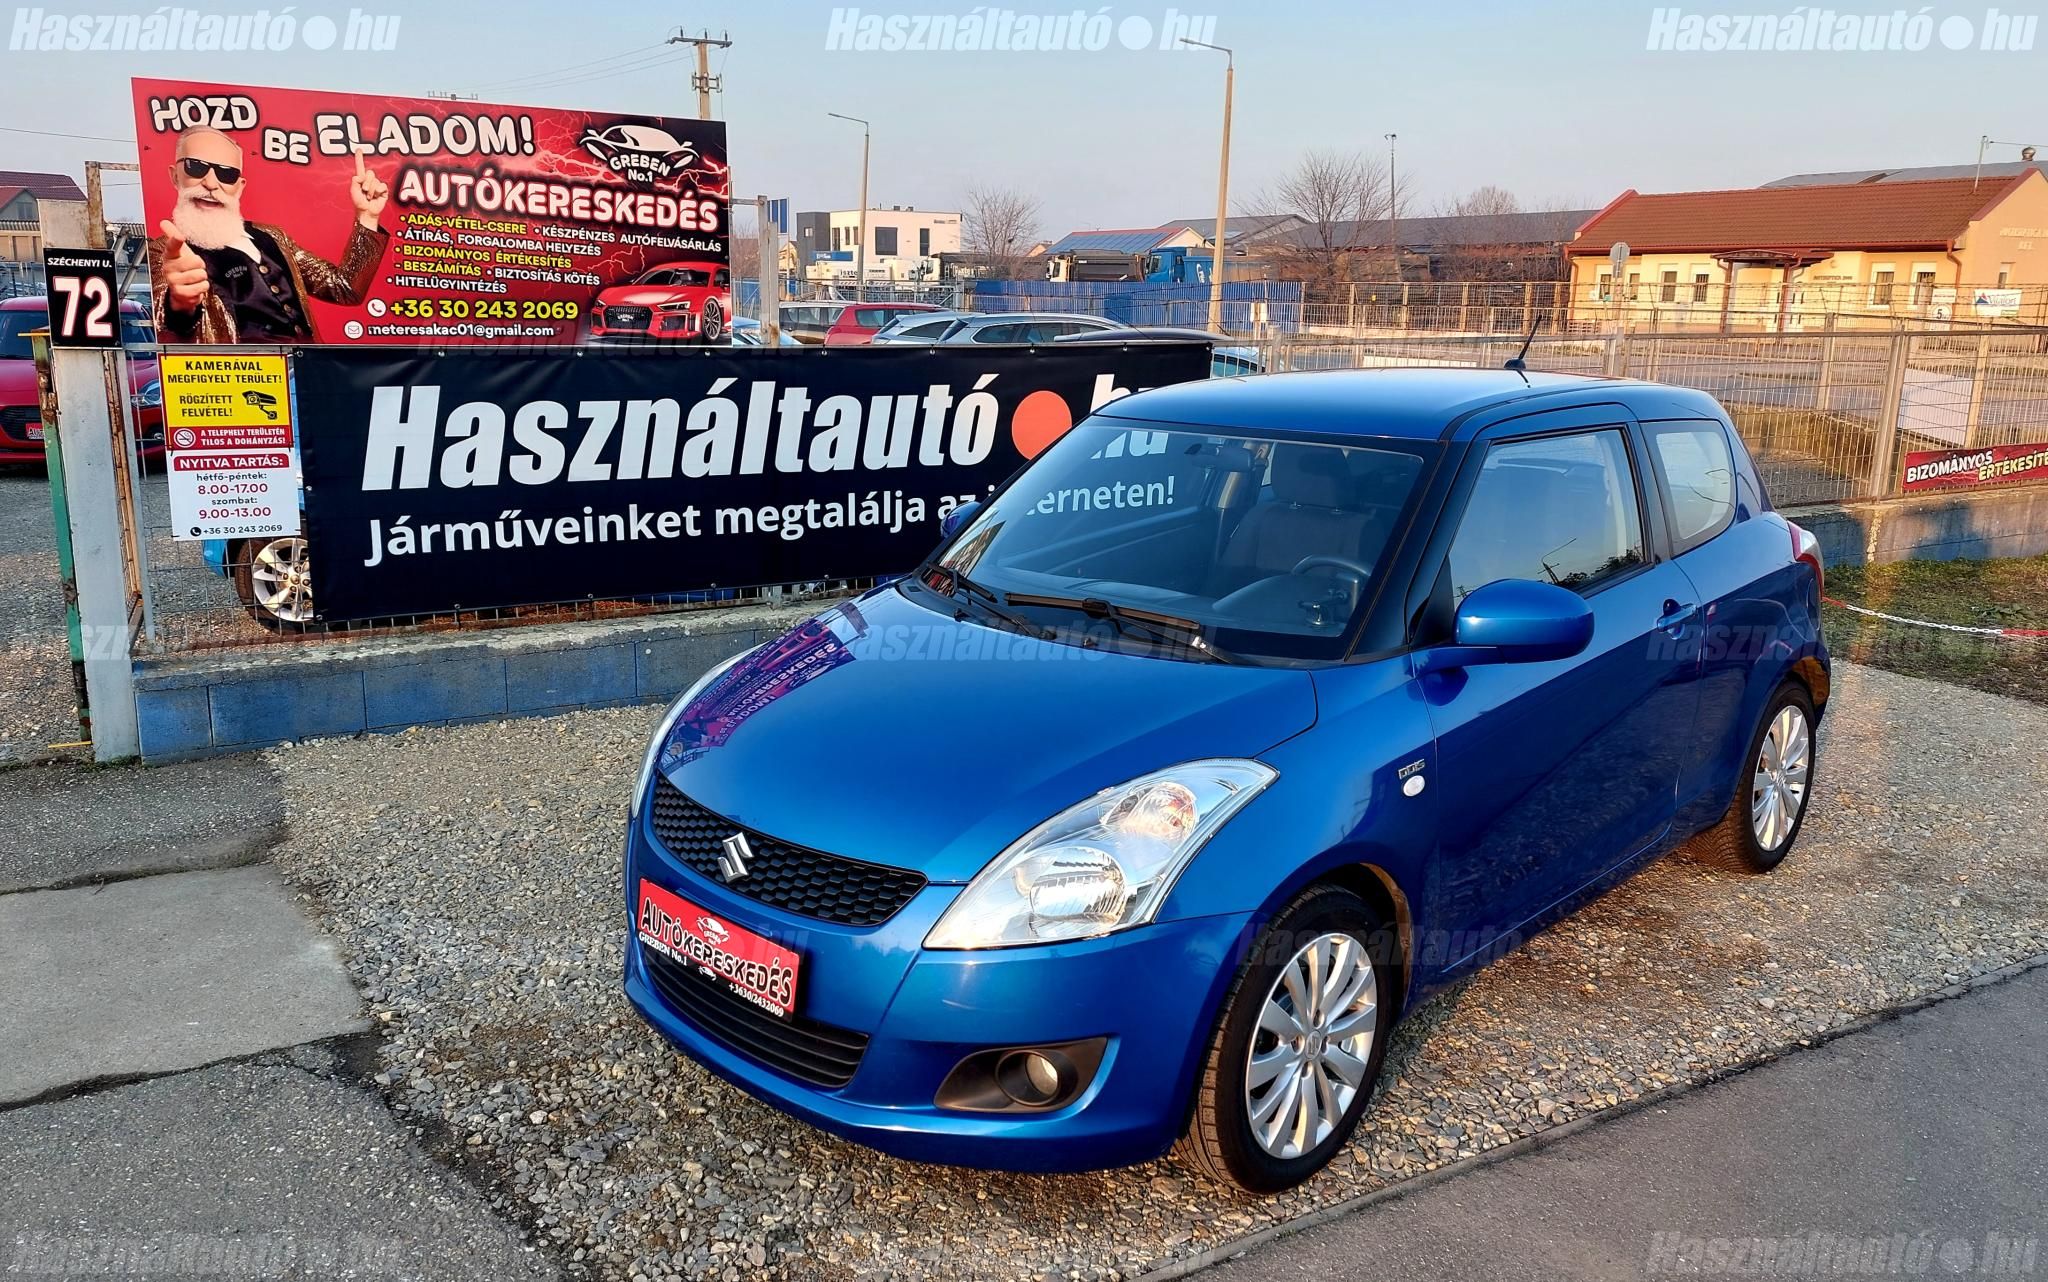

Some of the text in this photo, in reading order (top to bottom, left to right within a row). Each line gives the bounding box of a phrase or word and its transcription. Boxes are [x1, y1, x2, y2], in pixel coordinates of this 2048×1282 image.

[151, 97, 257, 131] HOZD
[316, 115, 534, 154] ELADOM!
[264, 129, 310, 164] BE
[610, 154, 671, 176] GREBEN
[627, 169, 653, 182] No.1
[400, 168, 719, 233] AUTÓKERESKEDÉS
[404, 228, 601, 256] ÁTÍRÁS, FORGALOMBA HELYEZÉS
[407, 213, 722, 252] ADÁS-VÉTEL-CSERE KÉSZPÉNZES AUTÓFELVÁSÁRLÁS
[47, 256, 112, 268] SZÉCHENYI U.
[403, 245, 572, 268] BIZOMÁNYOS ÉRTÉKESÍTÉS
[403, 260, 601, 286] BESZÁMÍTÁS BIZTOSÍTÁS KÖTÉS
[395, 275, 508, 294] HITELÜGYINTÉZÉS
[52, 275, 113, 337] 72
[390, 300, 578, 320] +36 30 243 2069
[185, 359, 263, 371] KAMERÁVAL
[168, 373, 282, 384] MEGFIGYELT TERÜLET!
[179, 393, 233, 405] RÖGZÍTETT
[182, 406, 233, 417] FELVÉTEL!
[201, 438, 225, 446] TILOS
[235, 436, 286, 445] DOHÁNYZÁS!
[207, 428, 245, 437] TELEPHELY
[246, 427, 285, 436] TERÜLETÉN
[361, 373, 1000, 492] Használtautó
[179, 455, 284, 470] NYITVA TARTÁS:
[1906, 451, 1993, 483] BIZOMÁNYOS
[197, 472, 267, 482] hétfő-péntek:
[198, 483, 269, 495] 8.00-17.00
[211, 496, 258, 506] szombat:
[199, 507, 272, 520] 9.00-13.00
[203, 525, 283, 536] +36 30 243 2069
[364, 504, 701, 567] Járműveinket
[715, 490, 925, 541] megtalálja
[638, 931, 688, 966] GREBEN No.1
[640, 897, 793, 1008] AUTÓKERESKEDÉS
[728, 982, 785, 1017] +3630/2432069
